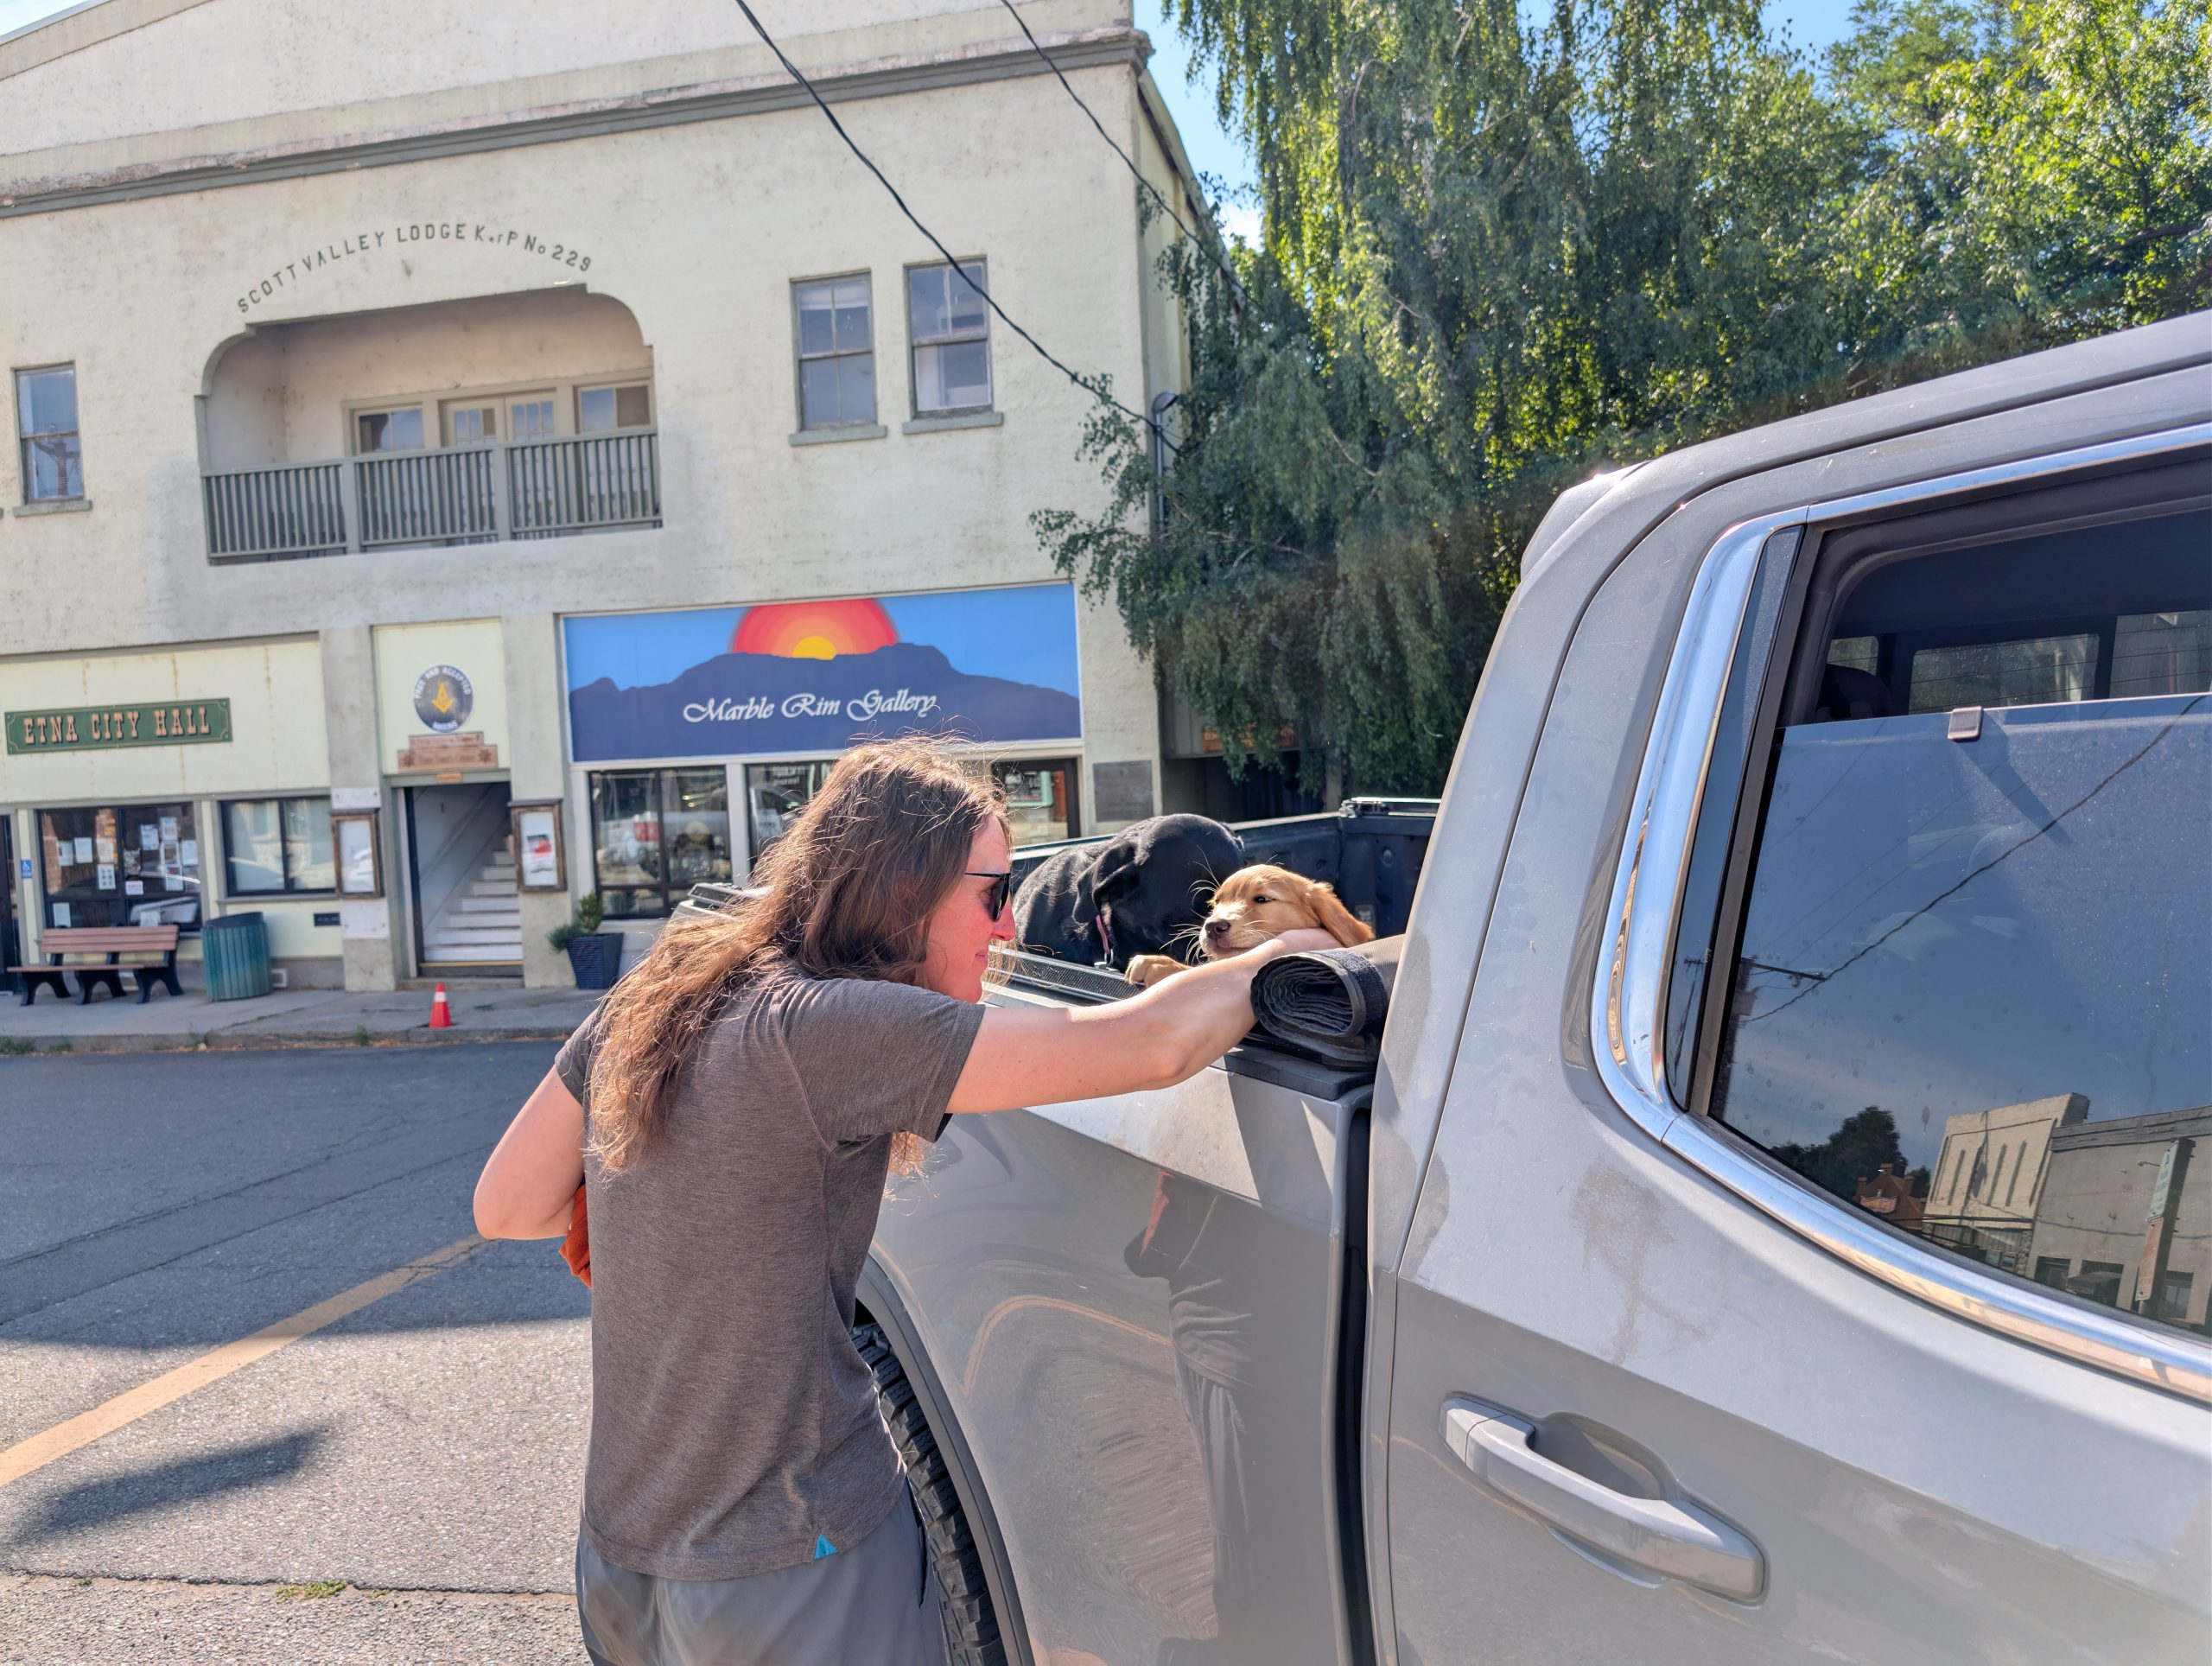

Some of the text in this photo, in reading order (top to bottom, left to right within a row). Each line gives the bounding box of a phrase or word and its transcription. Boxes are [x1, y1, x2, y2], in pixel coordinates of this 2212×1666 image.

[238, 264, 296, 313] SCOTT
[302, 232, 385, 271] VALLEY
[397, 224, 466, 243] LODGE
[551, 245, 591, 272] 229
[683, 688, 938, 723] Marble Rim Gallery
[23, 707, 211, 746] ETNA CITY HALL
